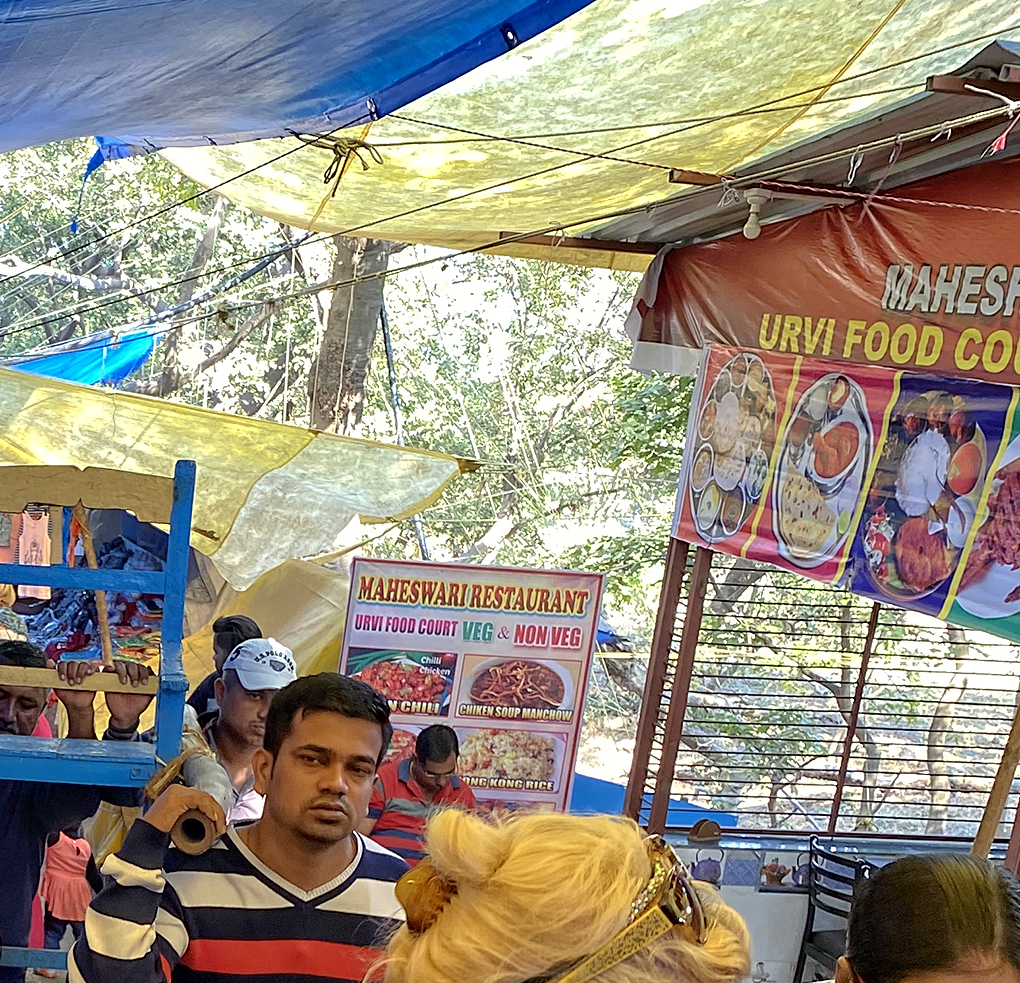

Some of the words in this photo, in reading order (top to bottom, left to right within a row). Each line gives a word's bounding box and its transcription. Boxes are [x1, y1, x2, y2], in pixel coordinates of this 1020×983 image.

[759, 313, 836, 356] URVI
[842, 320, 944, 366] FOOD
[954, 327, 1020, 374] CO
[357, 575, 469, 608] MAHESWARI
[469, 583, 589, 614] RESTAURANT
[354, 614, 384, 631] URVI
[385, 616, 416, 634] FOOD
[418, 618, 459, 637] COURT
[462, 621, 494, 642] VEG
[497, 626, 510, 640] &
[513, 624, 547, 645] NON
[549, 626, 582, 647] VEG
[421, 656, 442, 665] Chilli
[419, 666, 451, 676] Chicken
[400, 701, 440, 714] CHILI
[459, 705, 494, 717] CHIKEN
[495, 706, 521, 719] SOUP
[522, 708, 573, 722] MANCHOW
[459, 775, 487, 787] ONG
[489, 777, 523, 789] KONG
[524, 780, 554, 791] RICE
